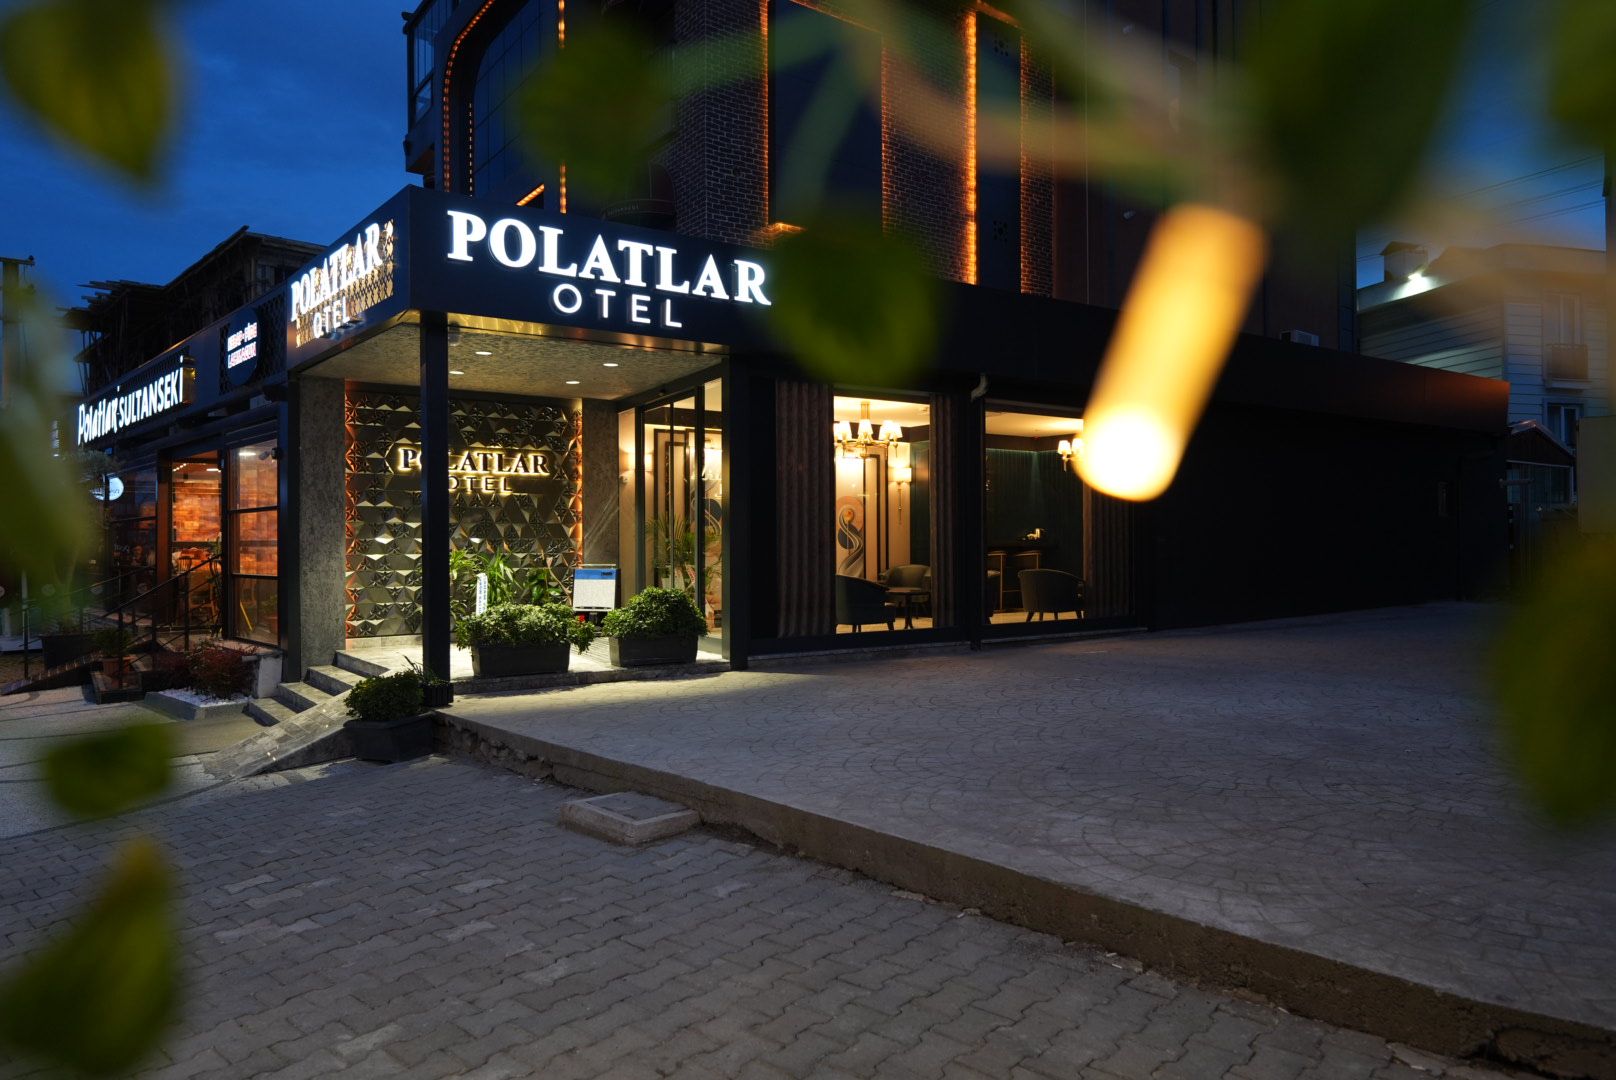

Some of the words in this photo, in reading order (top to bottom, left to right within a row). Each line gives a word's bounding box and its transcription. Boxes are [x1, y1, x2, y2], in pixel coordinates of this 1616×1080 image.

[291, 222, 383, 322] POLATLAR
[447, 210, 771, 305] POLATLAR
[313, 296, 350, 338] OTEL
[553, 283, 682, 327] OTEL
